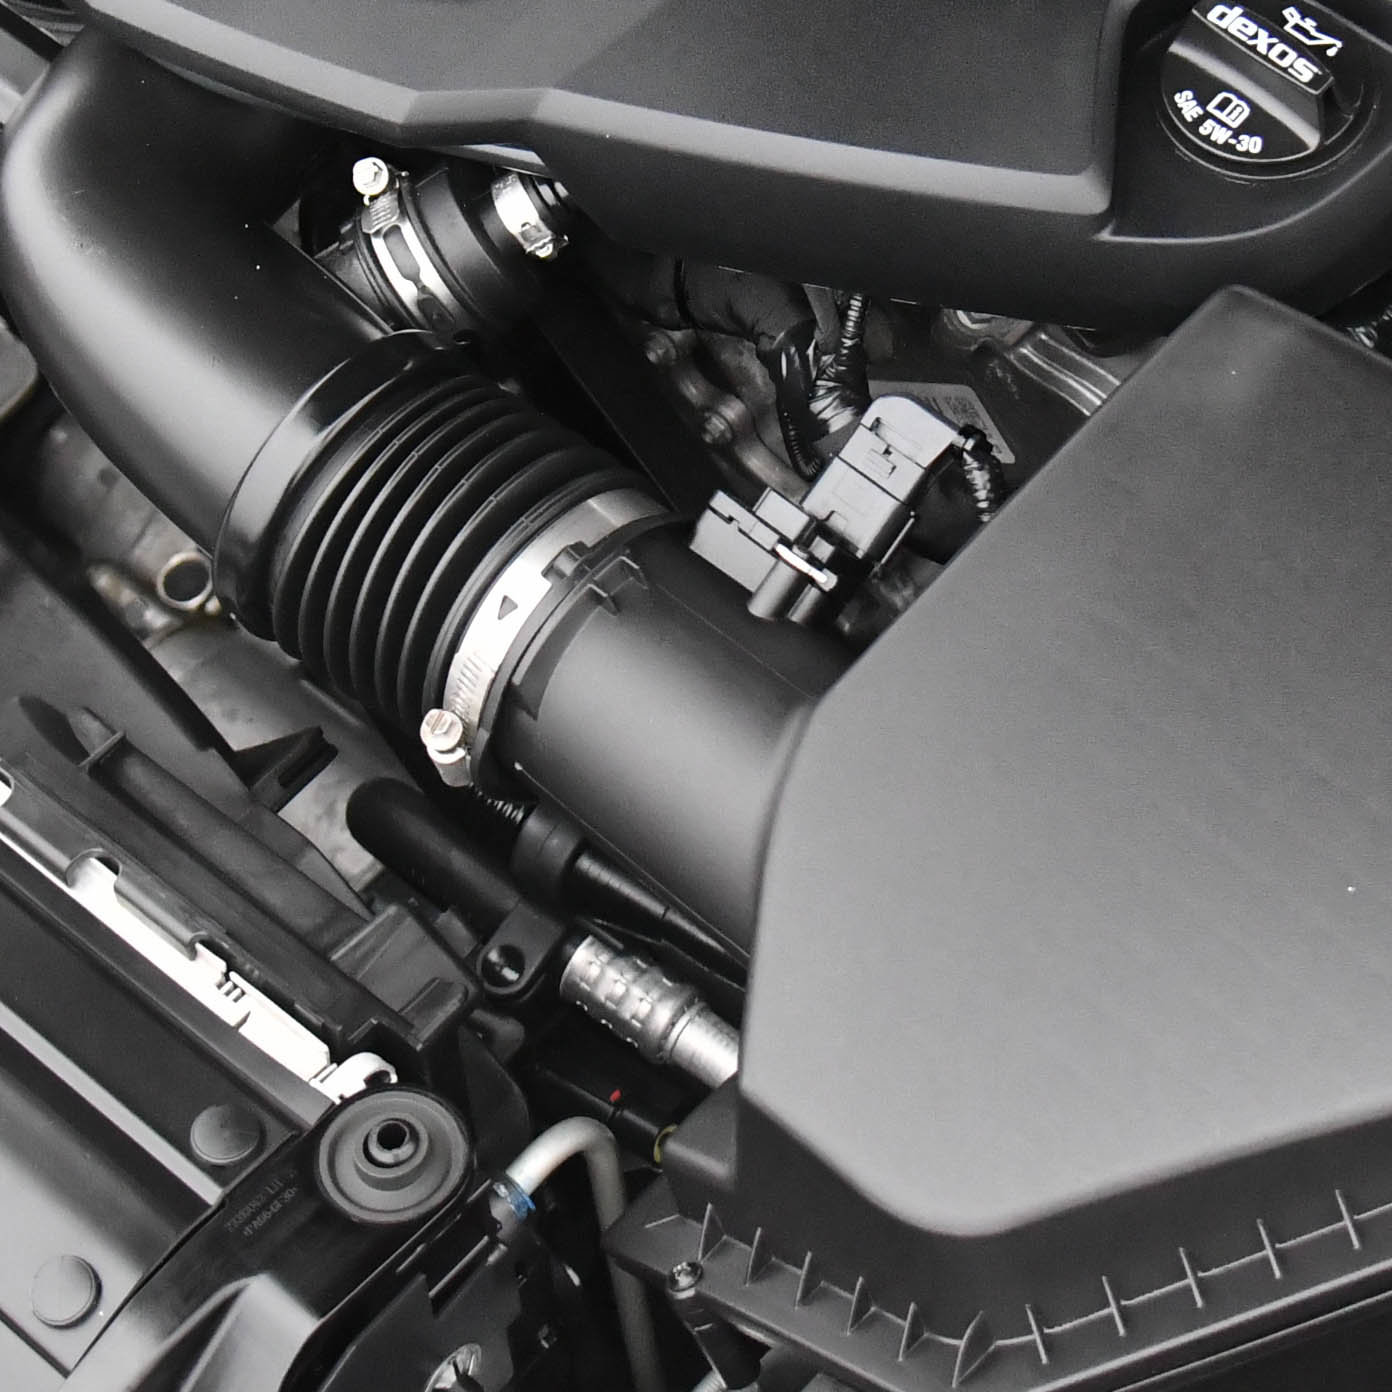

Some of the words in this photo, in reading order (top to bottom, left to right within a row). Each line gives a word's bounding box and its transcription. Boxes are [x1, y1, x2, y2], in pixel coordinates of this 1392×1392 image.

[1206, 4, 1317, 83] dexos
[1173, 90, 1204, 123] SAE
[1198, 118, 1263, 154] 5W-30
